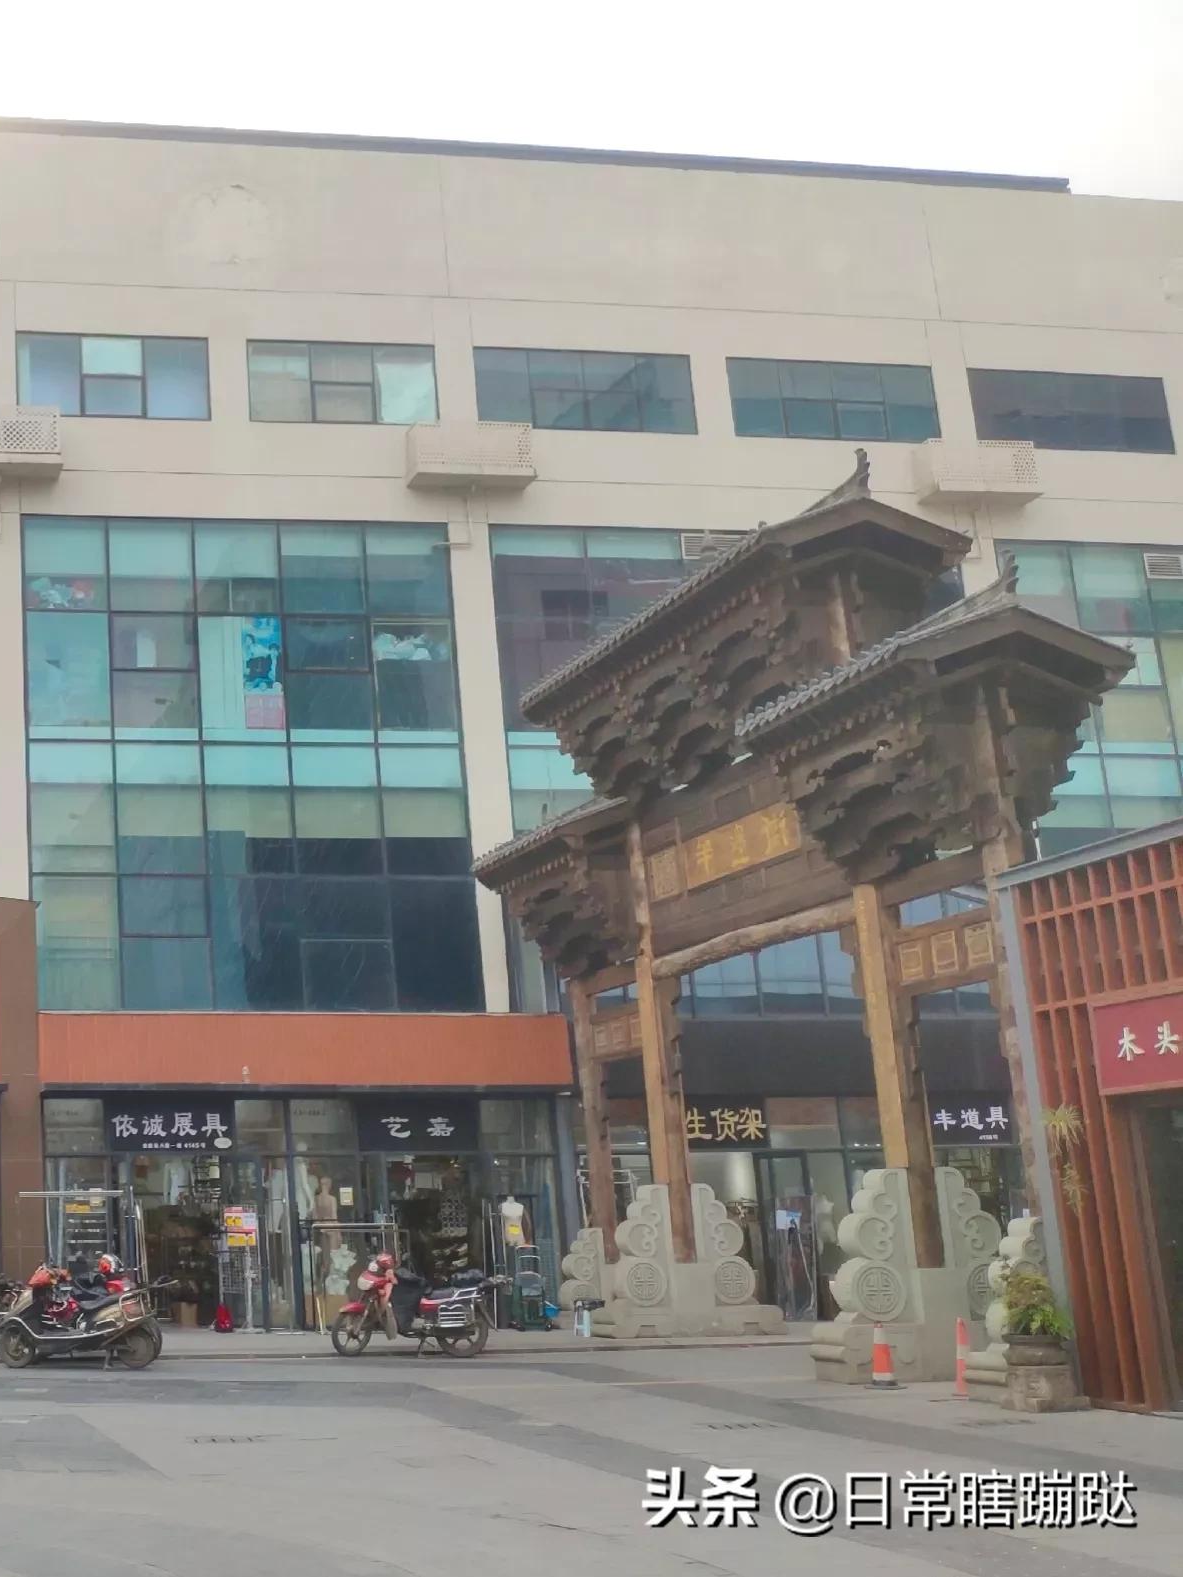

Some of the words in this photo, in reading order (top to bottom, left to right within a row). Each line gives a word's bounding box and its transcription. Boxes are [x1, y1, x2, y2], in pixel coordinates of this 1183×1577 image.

[111, 1112, 228, 1138] 依诚展具
[380, 1117, 455, 1138] 艺嘉
[933, 1106, 1009, 1130] 丰道具
